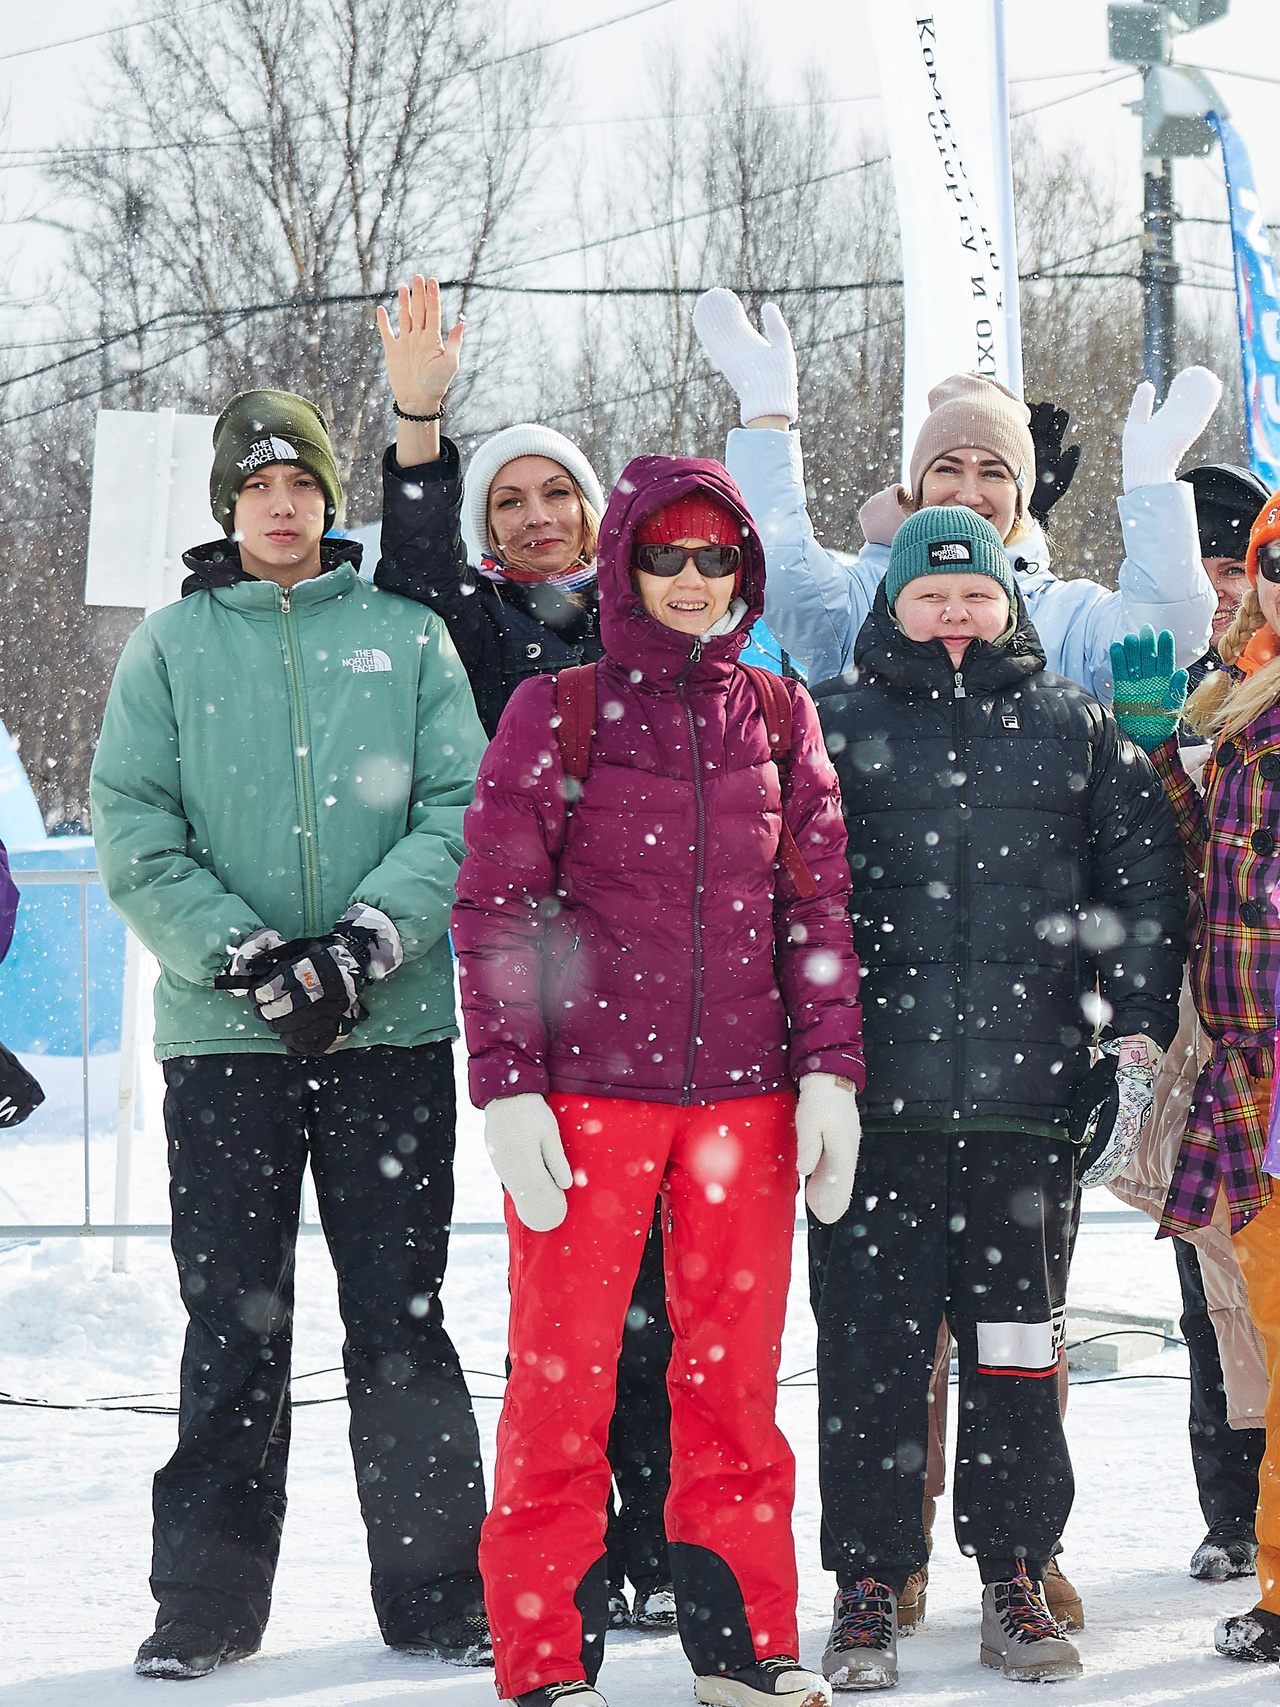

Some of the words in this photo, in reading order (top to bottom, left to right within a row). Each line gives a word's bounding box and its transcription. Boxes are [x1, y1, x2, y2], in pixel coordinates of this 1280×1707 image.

[249, 440, 271, 452] THE
[236, 445, 273, 470] NORTH
[249, 453, 275, 470] FACE
[353, 649, 372, 657] THE
[342, 657, 373, 667] NORTH
[352, 665, 375, 673] FACE
